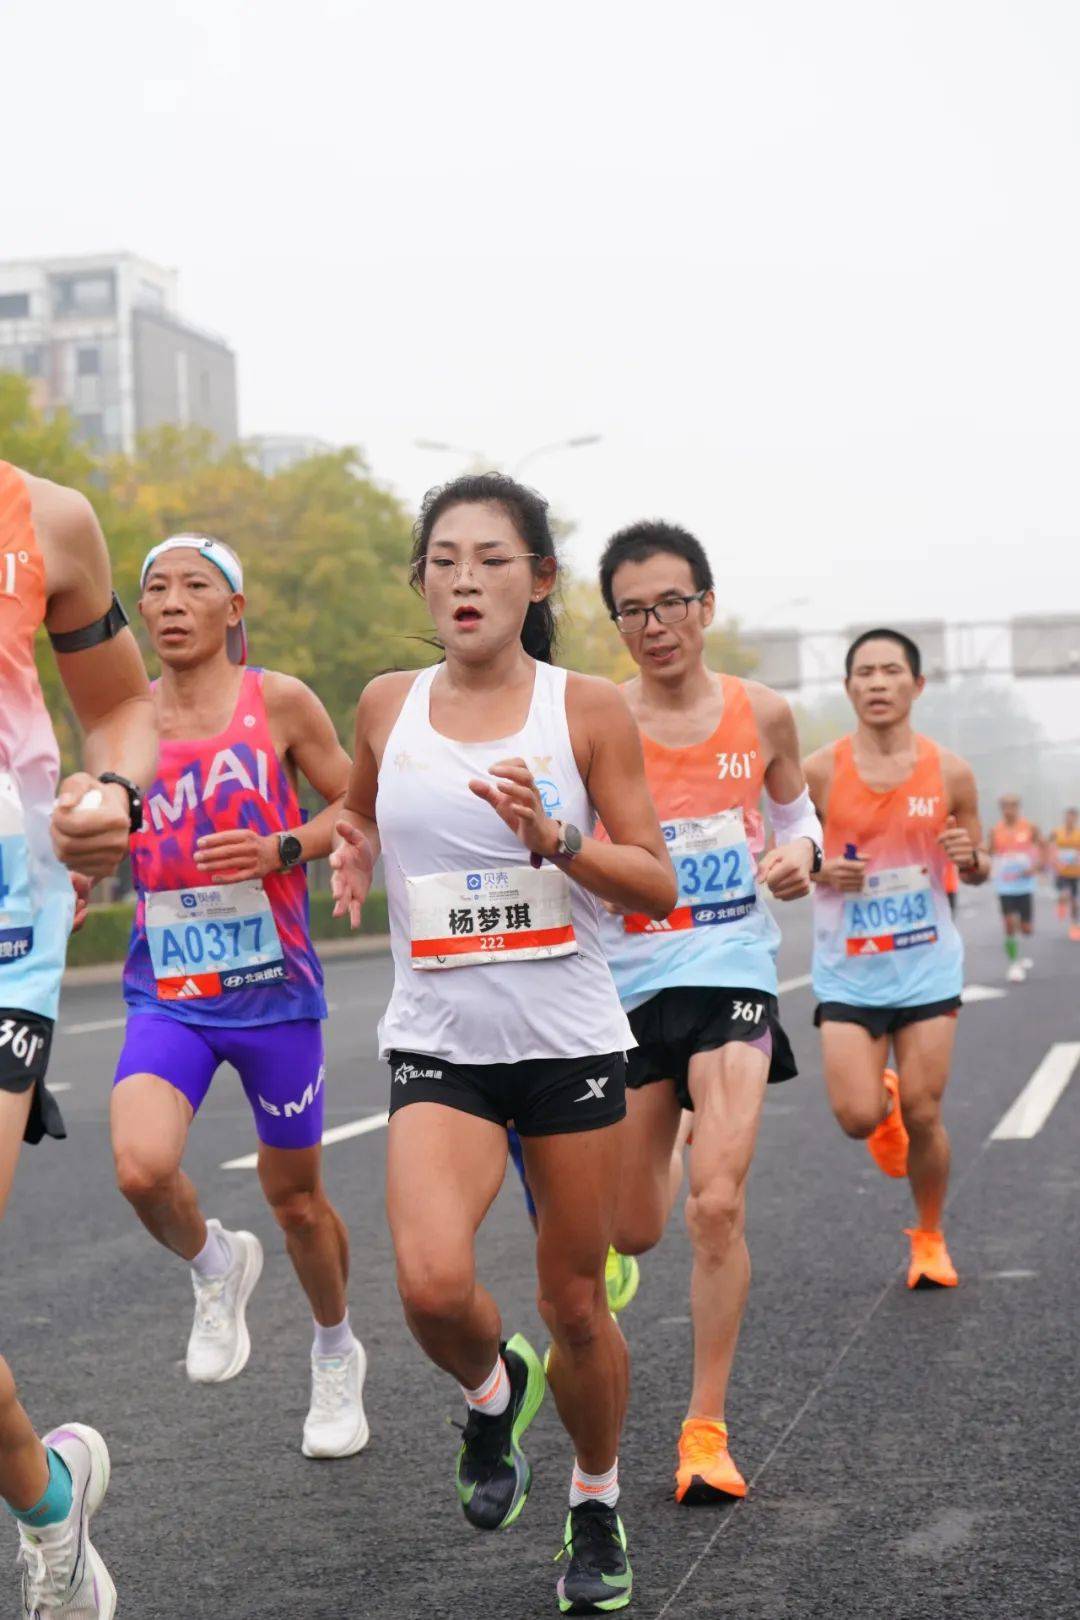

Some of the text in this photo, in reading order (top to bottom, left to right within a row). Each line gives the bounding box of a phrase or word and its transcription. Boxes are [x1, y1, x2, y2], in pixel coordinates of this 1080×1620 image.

[449, 903, 532, 935] 杨梦琪
[851, 893, 927, 930] A0643
[162, 917, 263, 967] A0377
[480, 936, 505, 950] 222
